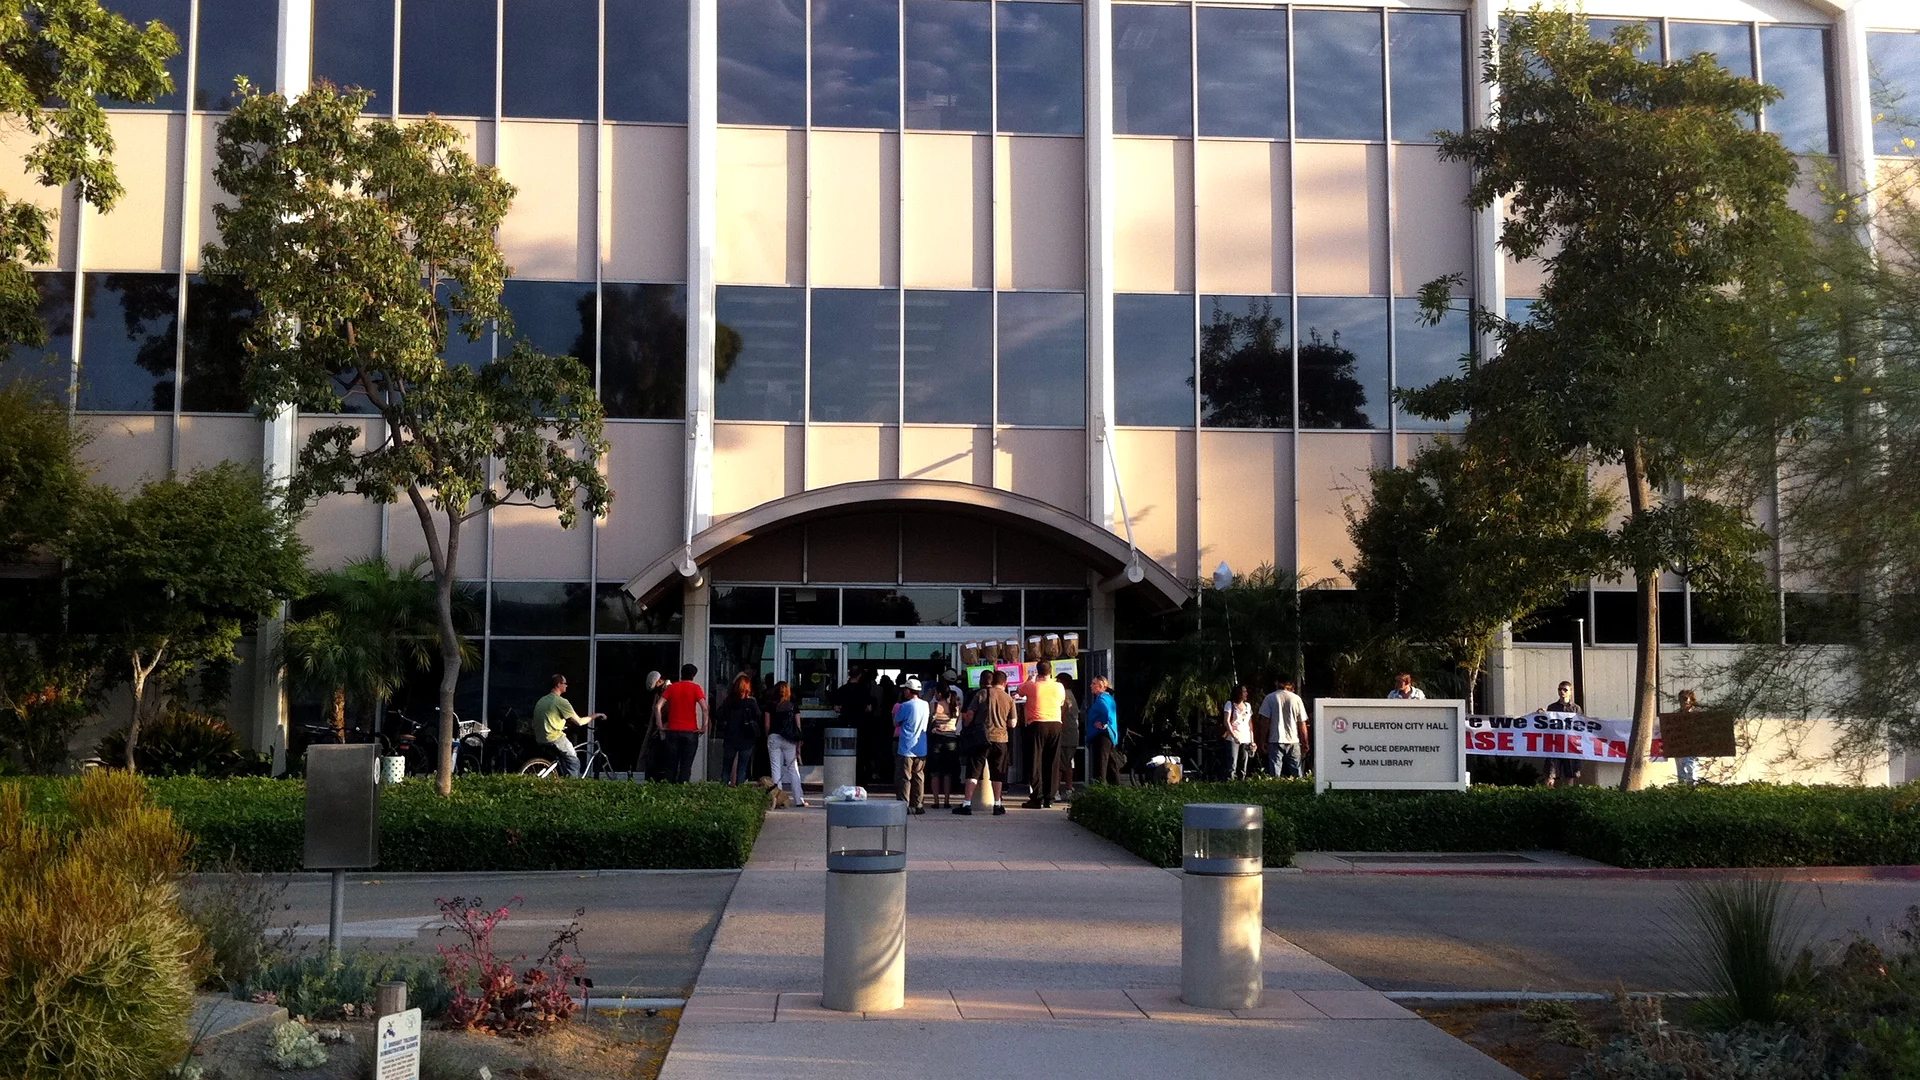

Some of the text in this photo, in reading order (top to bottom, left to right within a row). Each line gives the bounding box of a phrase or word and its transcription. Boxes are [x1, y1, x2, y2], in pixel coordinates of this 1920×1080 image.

[1352, 721, 1449, 730] FULLERTON CITY HALL
[1534, 715, 1602, 733] Safe?
[1359, 745, 1440, 753] POLICE DEPARTMENT
[1522, 732, 1583, 754] THE
[1590, 737, 1664, 758] TAE
[1359, 759, 1414, 767] MAIN LIBRARY
